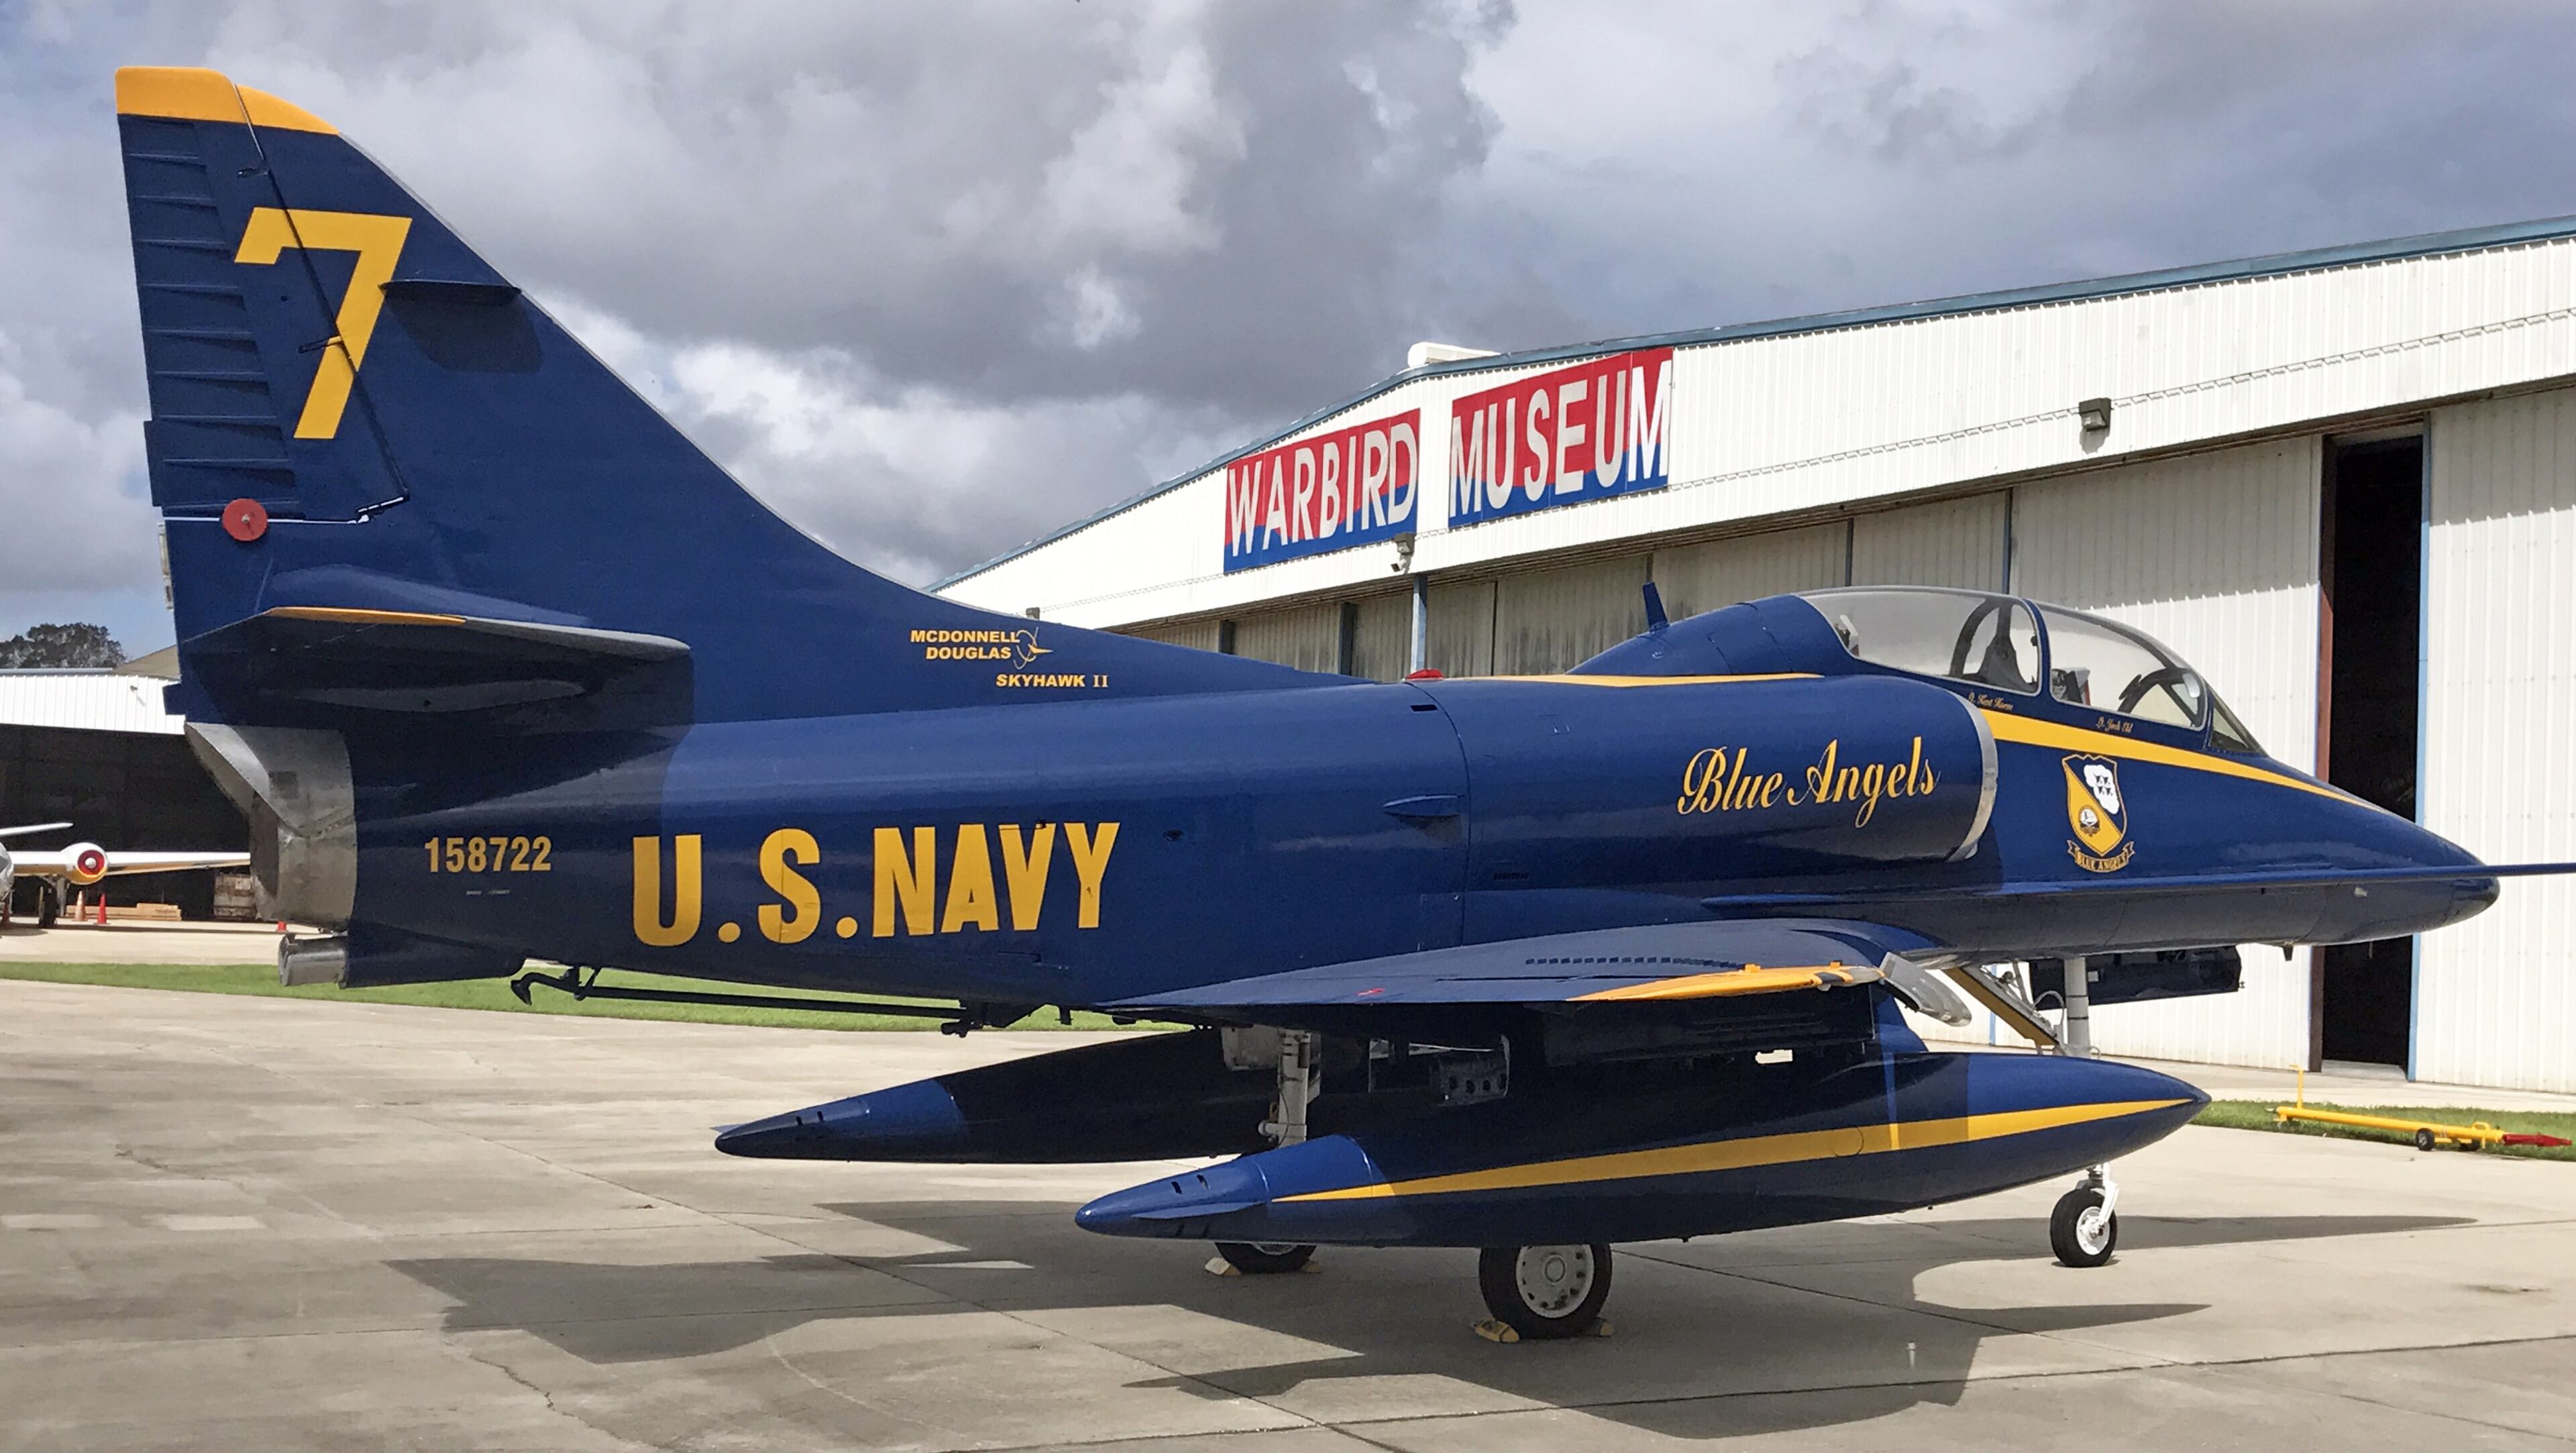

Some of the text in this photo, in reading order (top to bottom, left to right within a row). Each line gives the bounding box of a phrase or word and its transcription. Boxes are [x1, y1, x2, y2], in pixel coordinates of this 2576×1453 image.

[234, 207, 413, 439] 7
[1229, 360, 1672, 556] WARBIRD MUSEUM
[910, 629, 1020, 643] MCDONNELL
[926, 646, 1012, 660] DOUGLAS
[996, 674, 1108, 688] SKYHAWK II
[1678, 737, 1941, 828] Blue Angels
[425, 837, 551, 872] 158722
